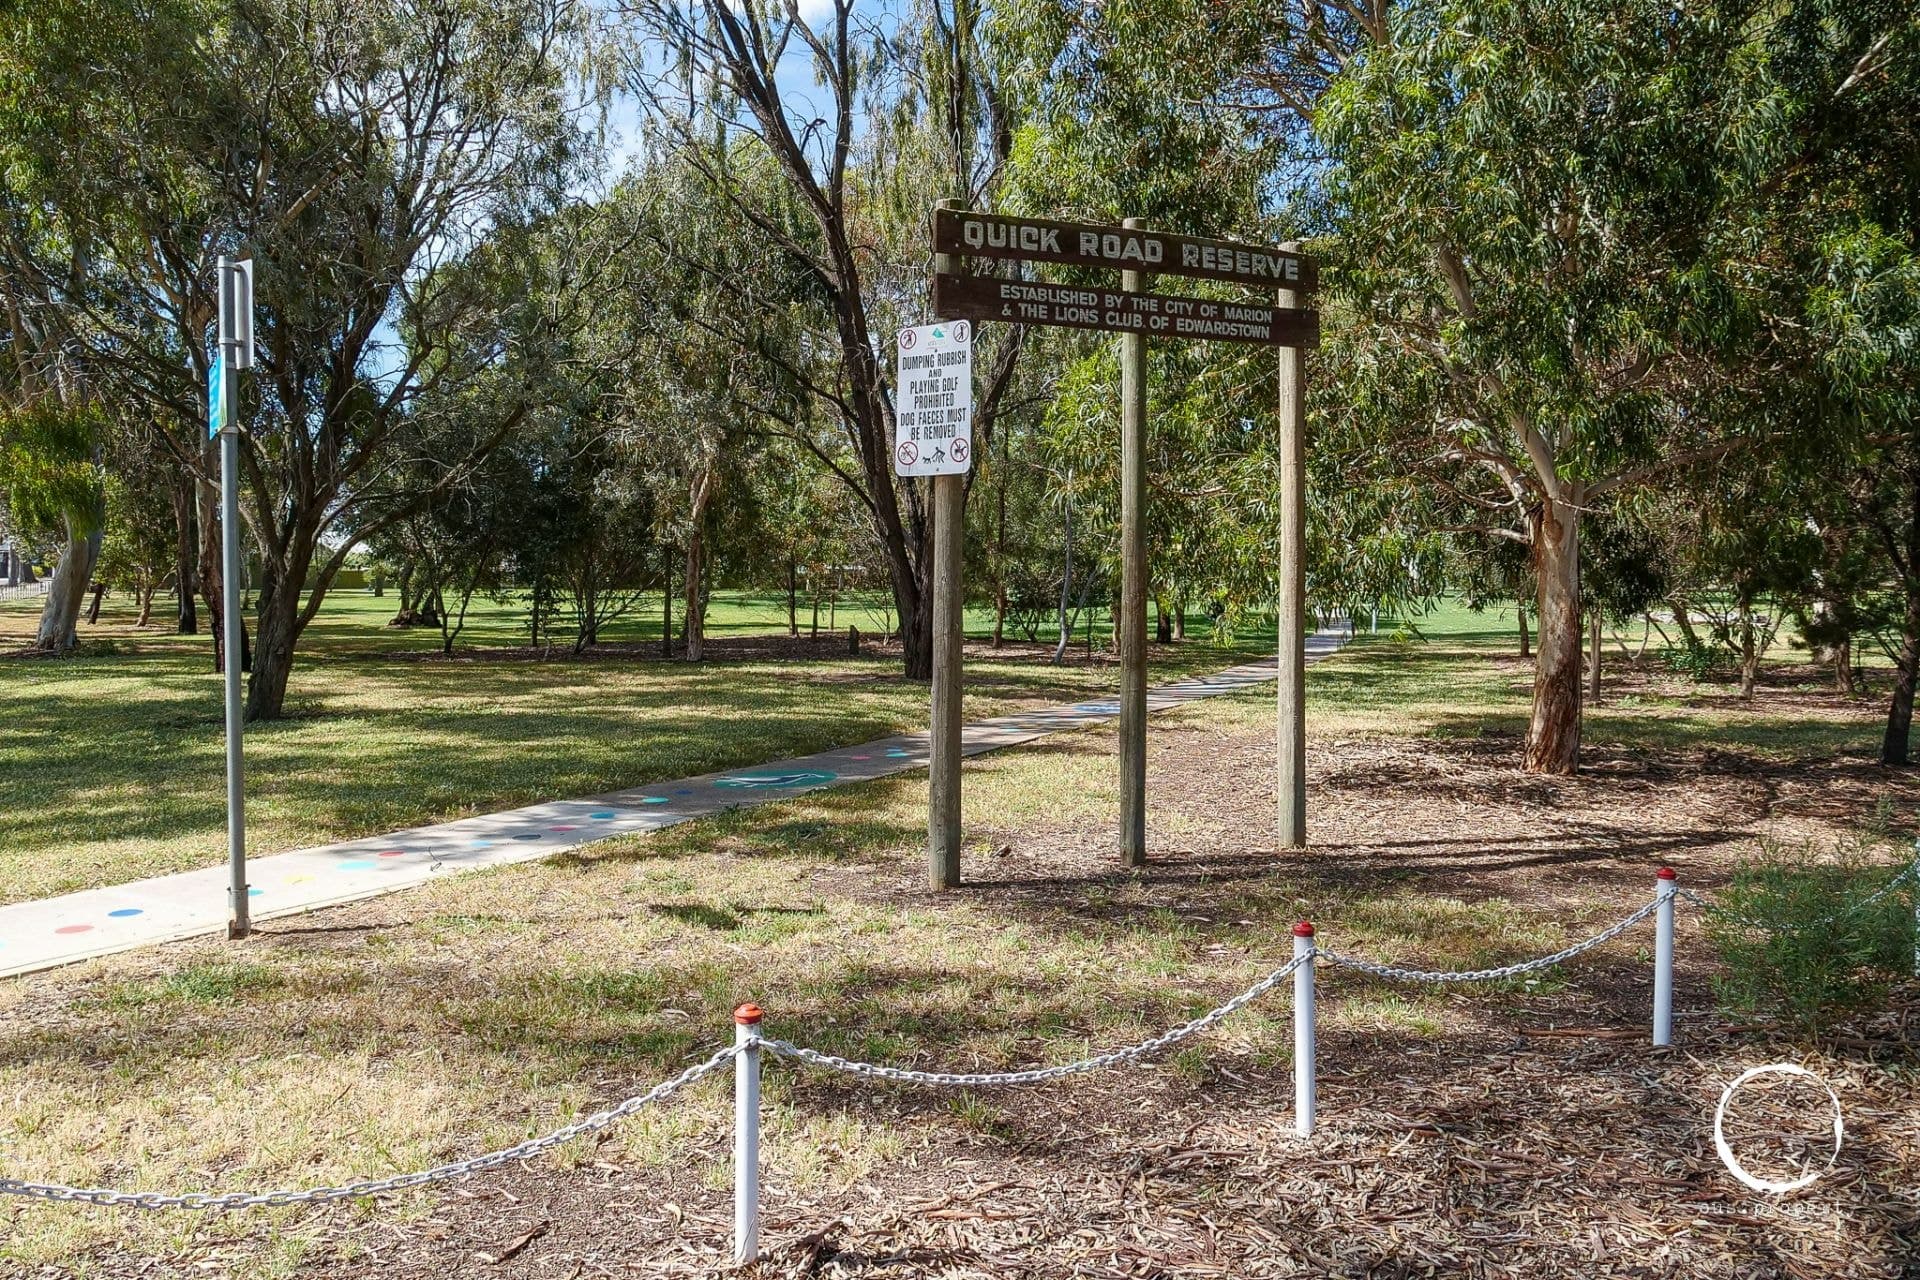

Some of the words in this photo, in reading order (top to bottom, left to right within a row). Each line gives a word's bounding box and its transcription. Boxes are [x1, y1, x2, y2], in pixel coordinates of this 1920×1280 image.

[964, 221, 1062, 254] QUICK
[1079, 232, 1163, 263] ROAD
[1182, 243, 1299, 281] RESERVE
[1001, 284, 1097, 306] ESTABLISHED
[1105, 294, 1124, 309] BY
[1131, 297, 1159, 313] THE
[1165, 300, 1193, 315] CITY
[1201, 303, 1219, 318] OF
[1224, 306, 1272, 323] MARION
[1001, 303, 1013, 316] &
[1019, 303, 1048, 319] THE
[1055, 307, 1099, 325] LIONS
[1149, 315, 1169, 330] OF
[1176, 317, 1270, 340] EDWARDSTOWN
[903, 354, 934, 370] DUMPING
[938, 351, 966, 367] RUBBISH
[929, 368, 942, 378] AND
[910, 379, 939, 395] PLAYING
[943, 377, 958, 391] GOLF
[914, 393, 954, 409] PROHIBITED
[901, 413, 915, 426] DOG
[919, 410, 944, 425] FAECES
[948, 408, 966, 422] MUST
[911, 427, 921, 440] BE
[924, 424, 956, 440] REMOVED
